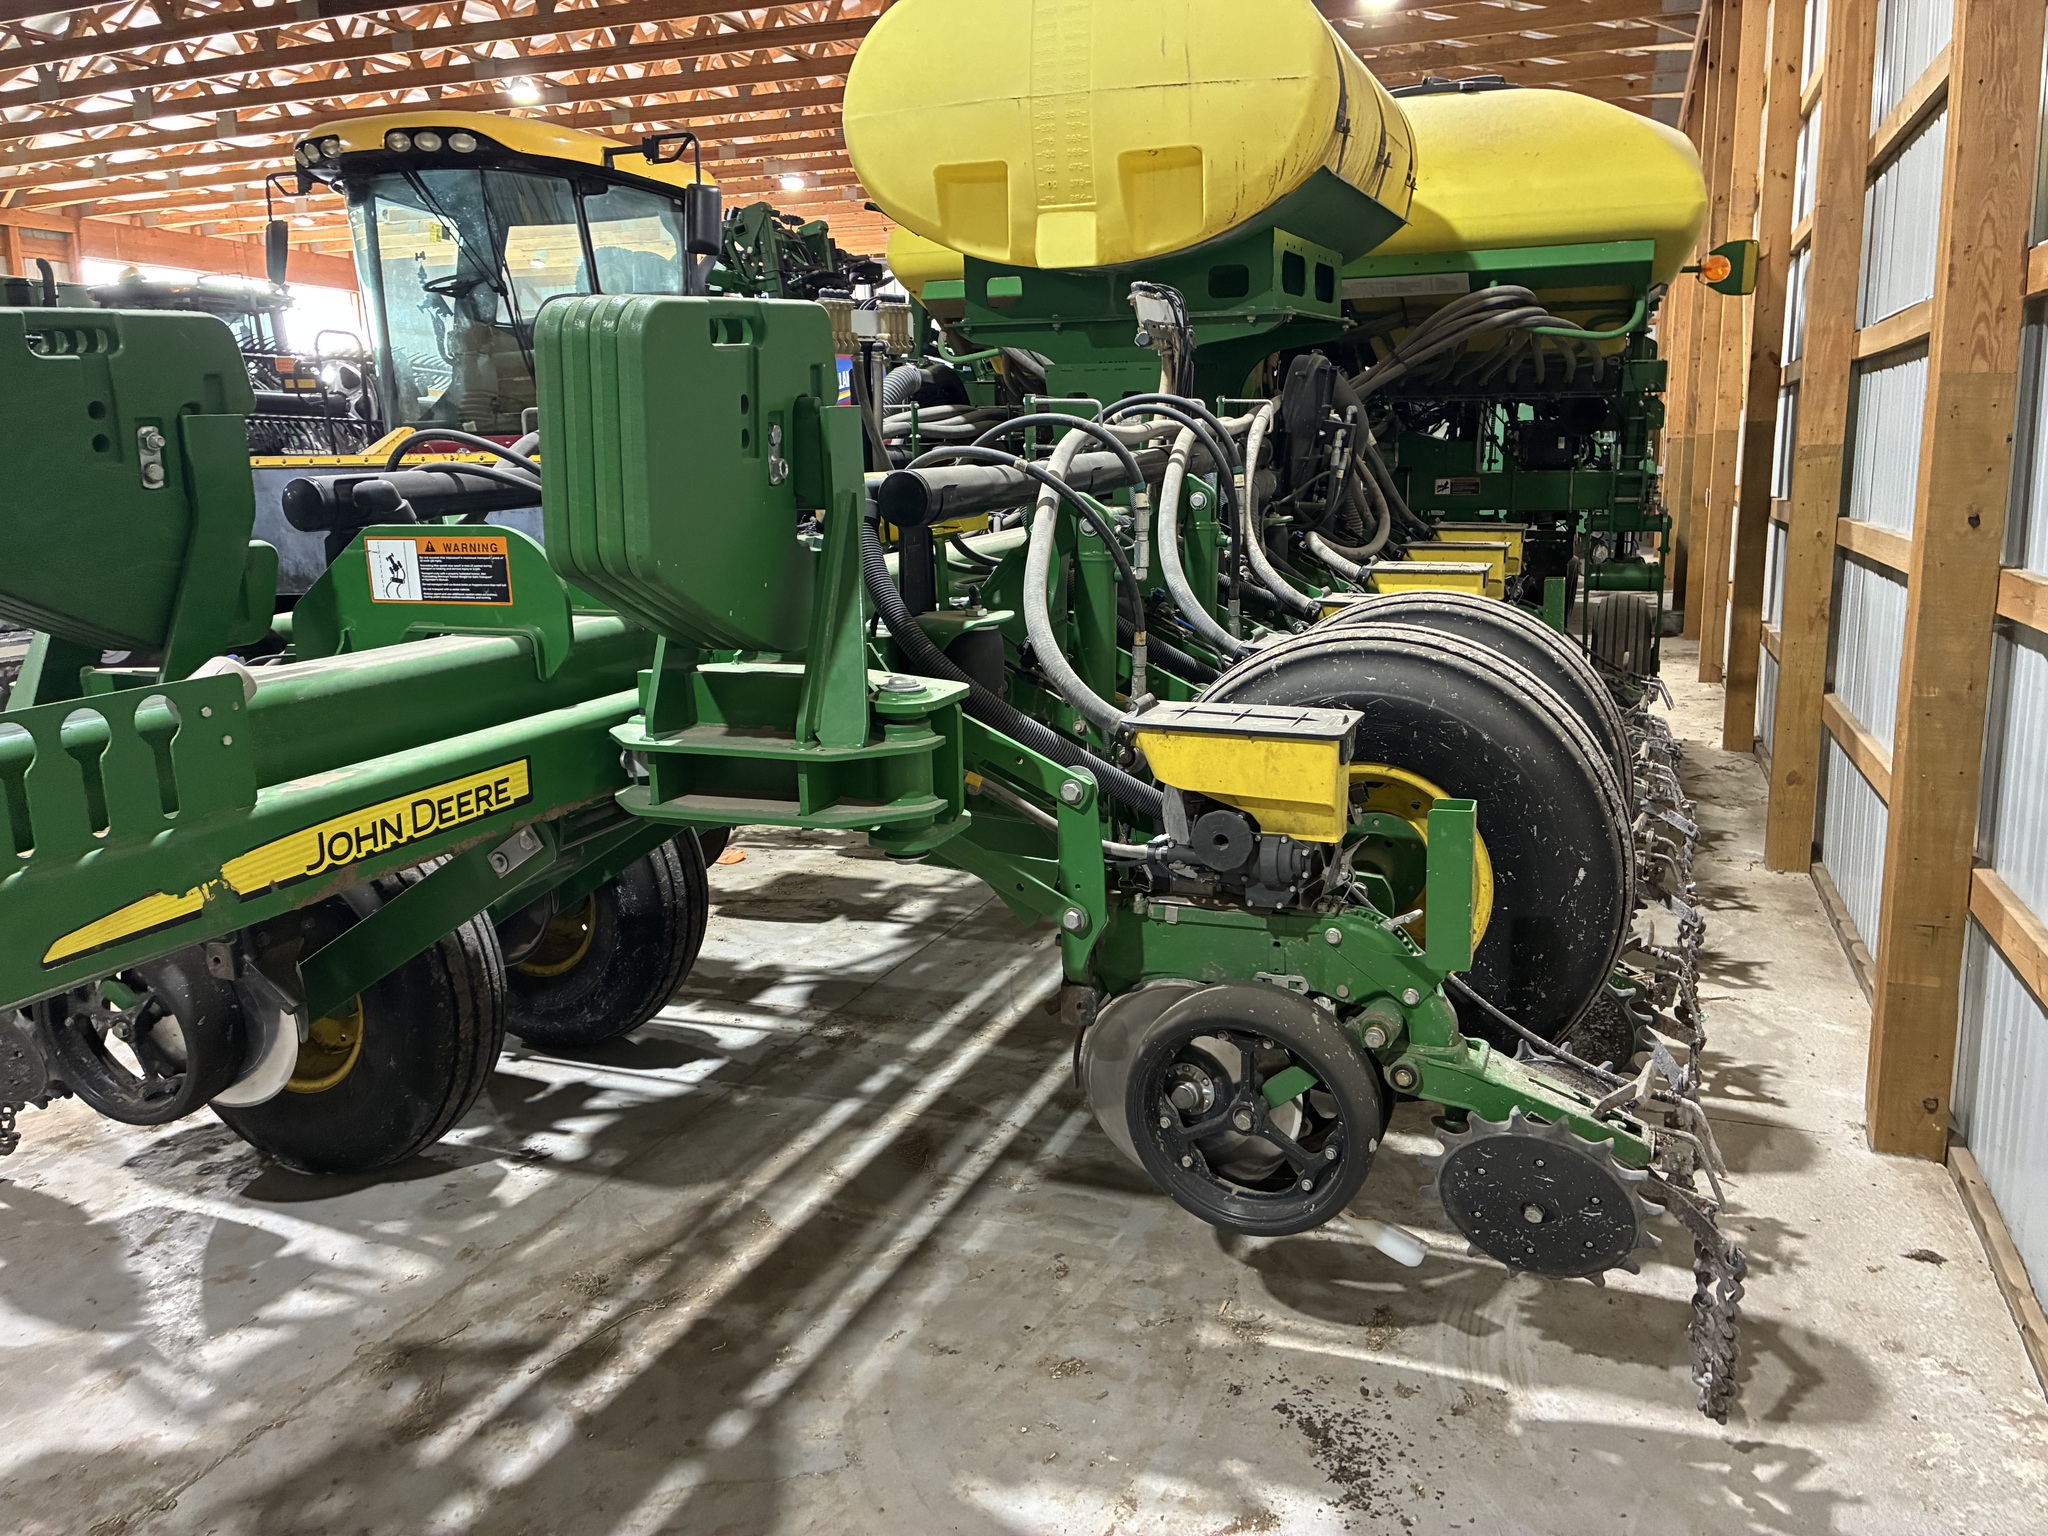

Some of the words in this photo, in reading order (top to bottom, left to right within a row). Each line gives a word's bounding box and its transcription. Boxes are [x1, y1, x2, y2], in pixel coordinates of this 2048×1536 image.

[442, 542, 498, 553] WARNING
[306, 814, 403, 871] JOHN
[411, 777, 511, 834] DEERE
